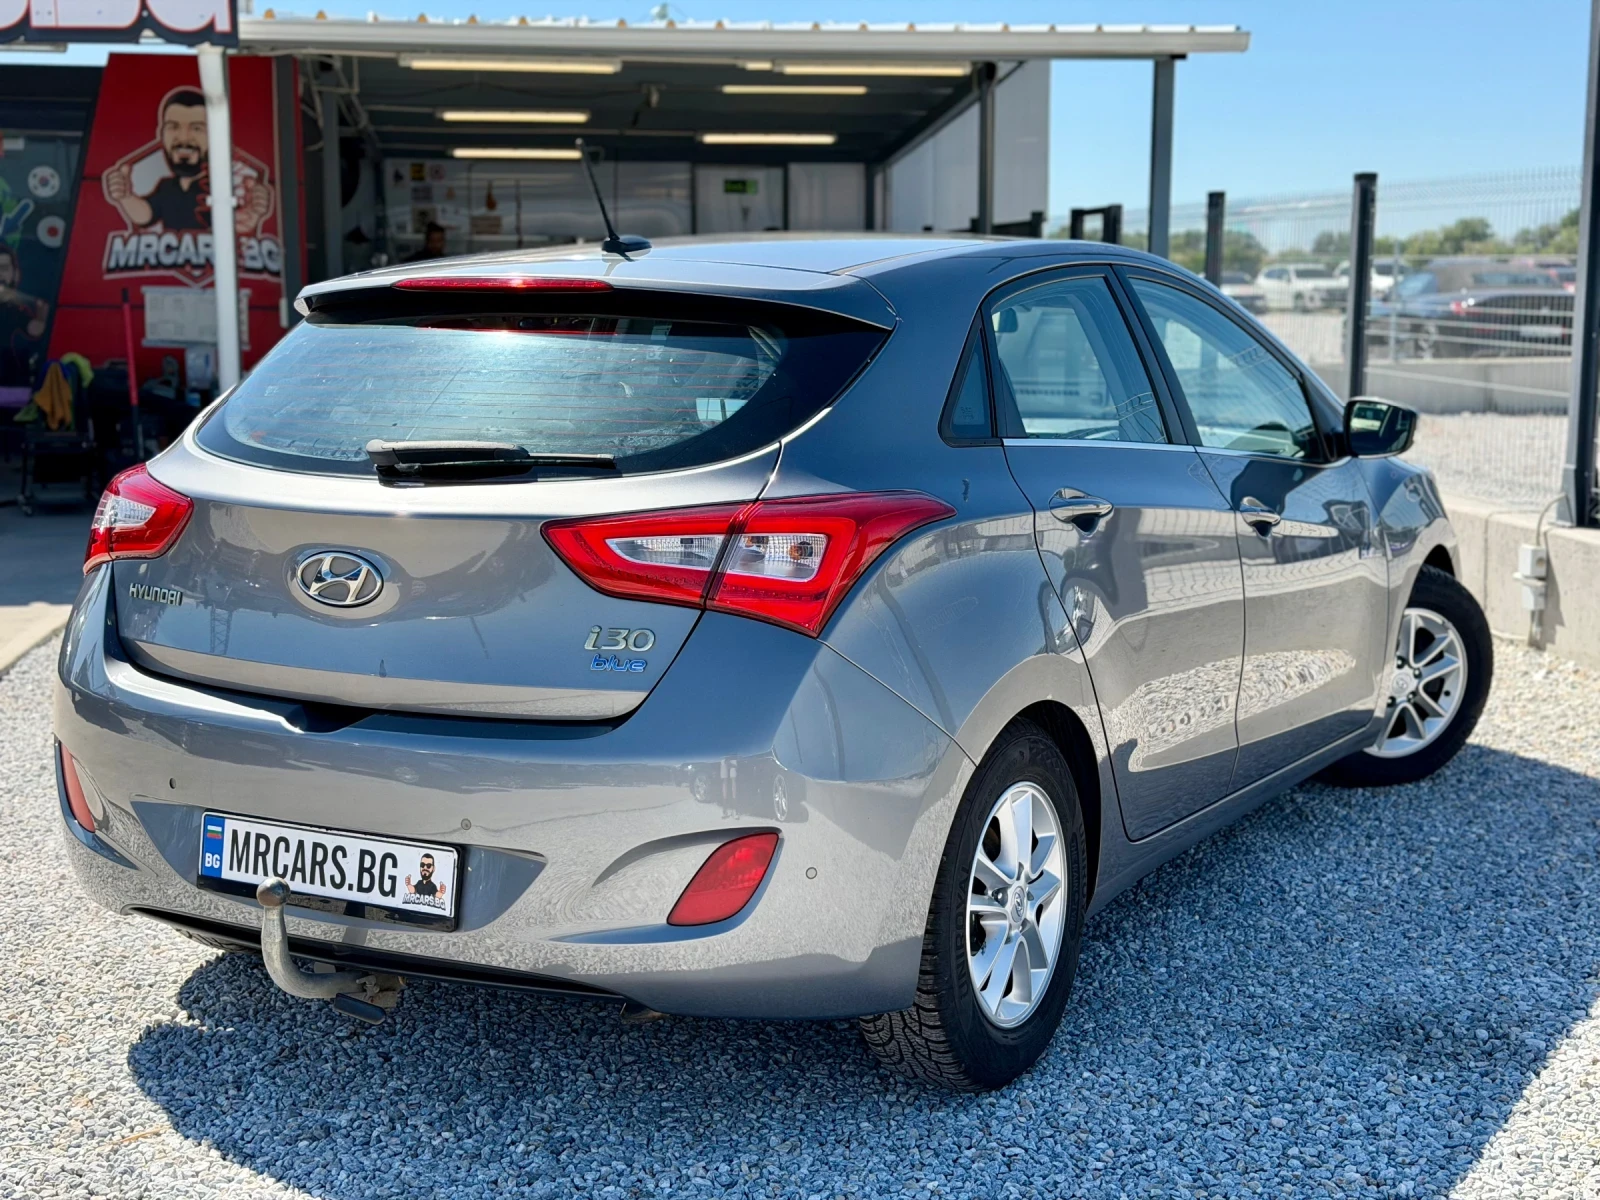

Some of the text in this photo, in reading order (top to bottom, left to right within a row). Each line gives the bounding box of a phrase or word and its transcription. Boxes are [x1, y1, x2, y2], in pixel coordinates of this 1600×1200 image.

[108, 232, 282, 273] MRCARBG
[129, 582, 183, 606] HYUNDAI
[583, 625, 656, 652] i30
[590, 653, 647, 673] blue
[204, 852, 221, 870] BG
[228, 828, 399, 899] MRCARS.BG
[955, 864, 972, 999] UNIROYAL
